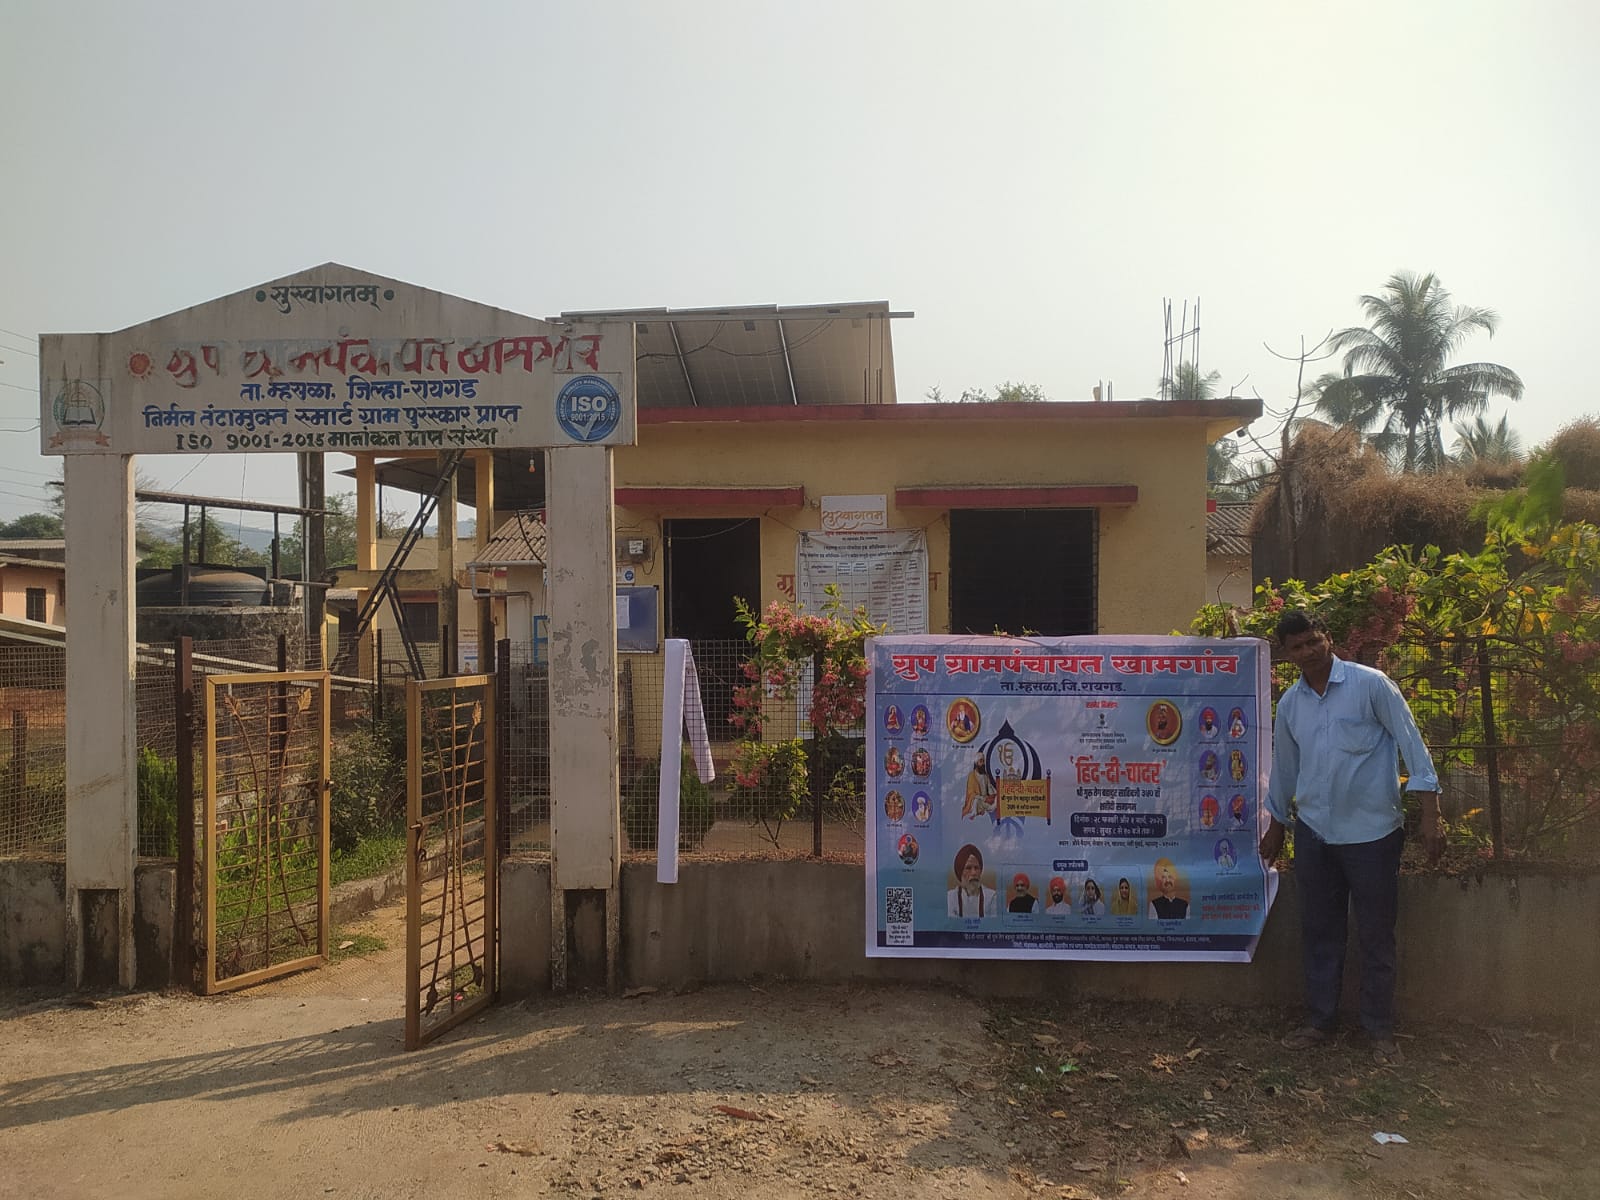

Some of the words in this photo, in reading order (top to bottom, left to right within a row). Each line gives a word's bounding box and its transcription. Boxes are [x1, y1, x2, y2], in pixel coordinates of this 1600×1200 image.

[270, 284, 382, 313] सुस्वागतम्
[346, 374, 480, 404] जिल्हा-रायगड
[142, 403, 197, 428] निर्मल
[199, 404, 290, 432] तंटामुक्त
[294, 402, 354, 428] स्मार्ट
[357, 406, 400, 426] ग्राम
[401, 406, 471, 430] पुरस्कार
[474, 404, 523, 425] प्राप्त
[571, 395, 608, 413] ISO
[176, 434, 213, 450] ISO
[226, 432, 325, 449] 9001-2015
[446, 425, 499, 448] संस्था
[892, 654, 938, 681] ग्रुप
[944, 648, 1104, 676] ग्रामपंचायत
[1110, 648, 1239, 675] खामगांव
